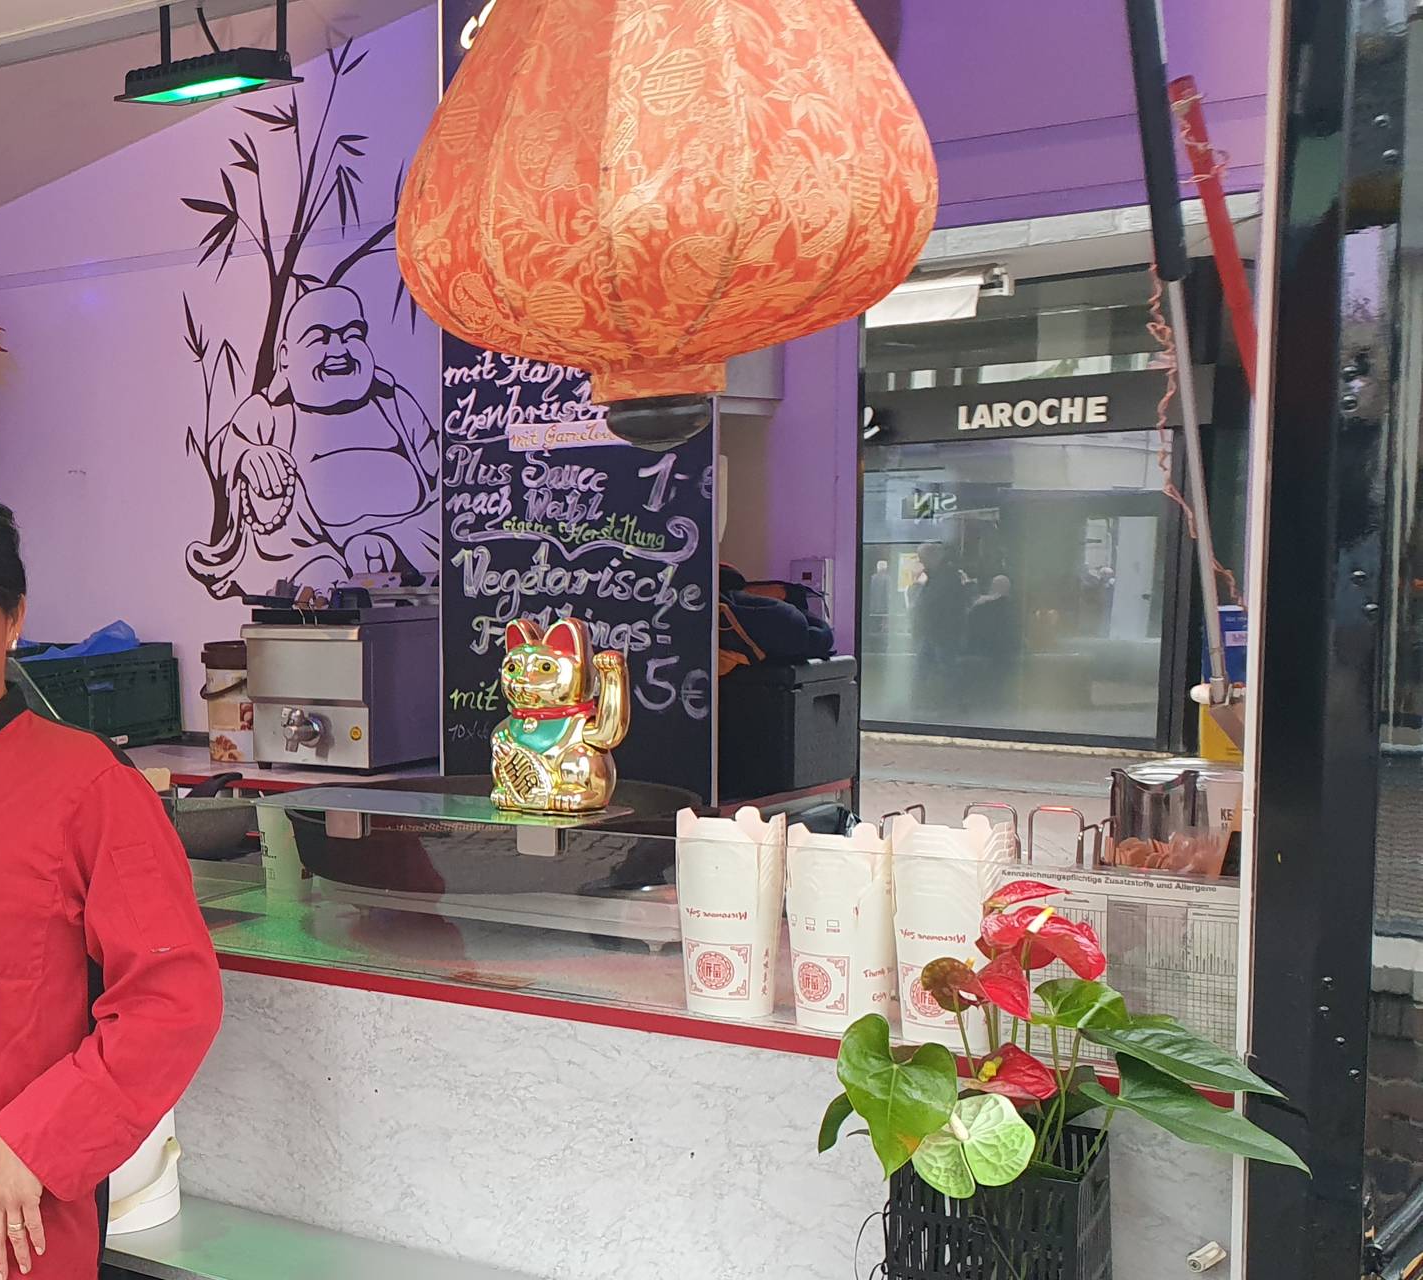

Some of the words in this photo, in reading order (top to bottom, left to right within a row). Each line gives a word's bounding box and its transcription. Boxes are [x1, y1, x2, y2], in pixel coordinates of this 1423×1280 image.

[443, 351, 498, 388] mit
[957, 396, 1108, 431] LAROCHE
[511, 430, 539, 447] mit
[443, 444, 514, 488] Plus
[521, 451, 609, 490] Sauce
[445, 485, 513, 530] nach
[524, 487, 604, 529] Wahl
[502, 516, 553, 539] eigene
[558, 513, 666, 550] Herstellung
[450, 543, 706, 630] Vegetarische
[450, 680, 500, 711] mit
[1001, 869, 1102, 885] Kennzeichnungspflichtige
[1104, 876, 1154, 889] Zusatzstoffe
[1156, 882, 1173, 890] und
[1175, 882, 1217, 893] Allergene
[703, 911, 748, 921] Microwave
[917, 933, 966, 944] Microwave
